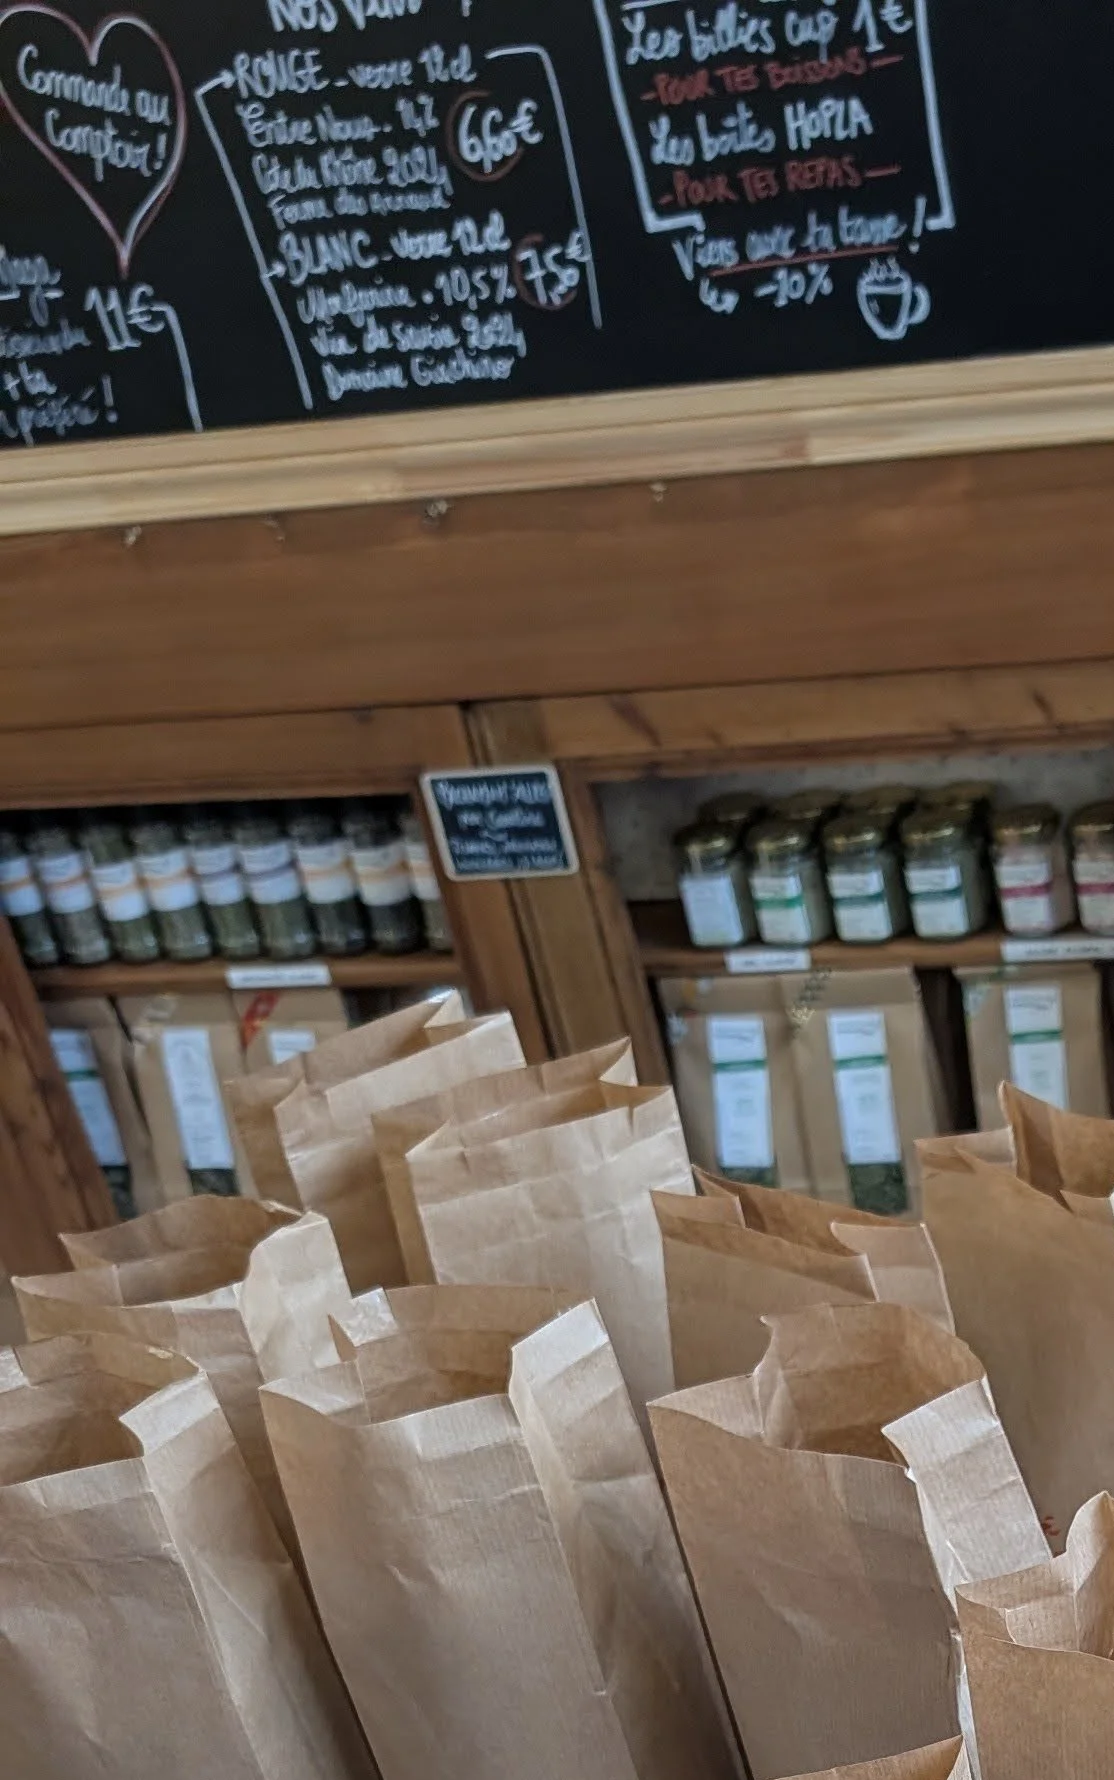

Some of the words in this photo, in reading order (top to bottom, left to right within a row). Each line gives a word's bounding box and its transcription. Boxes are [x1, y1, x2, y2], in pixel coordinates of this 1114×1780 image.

[622, 10, 682, 65] Les
[17, 43, 131, 116] Commande
[135, 88, 172, 126] au
[233, 48, 330, 99] ROUGE
[279, 229, 378, 287] BLANC
